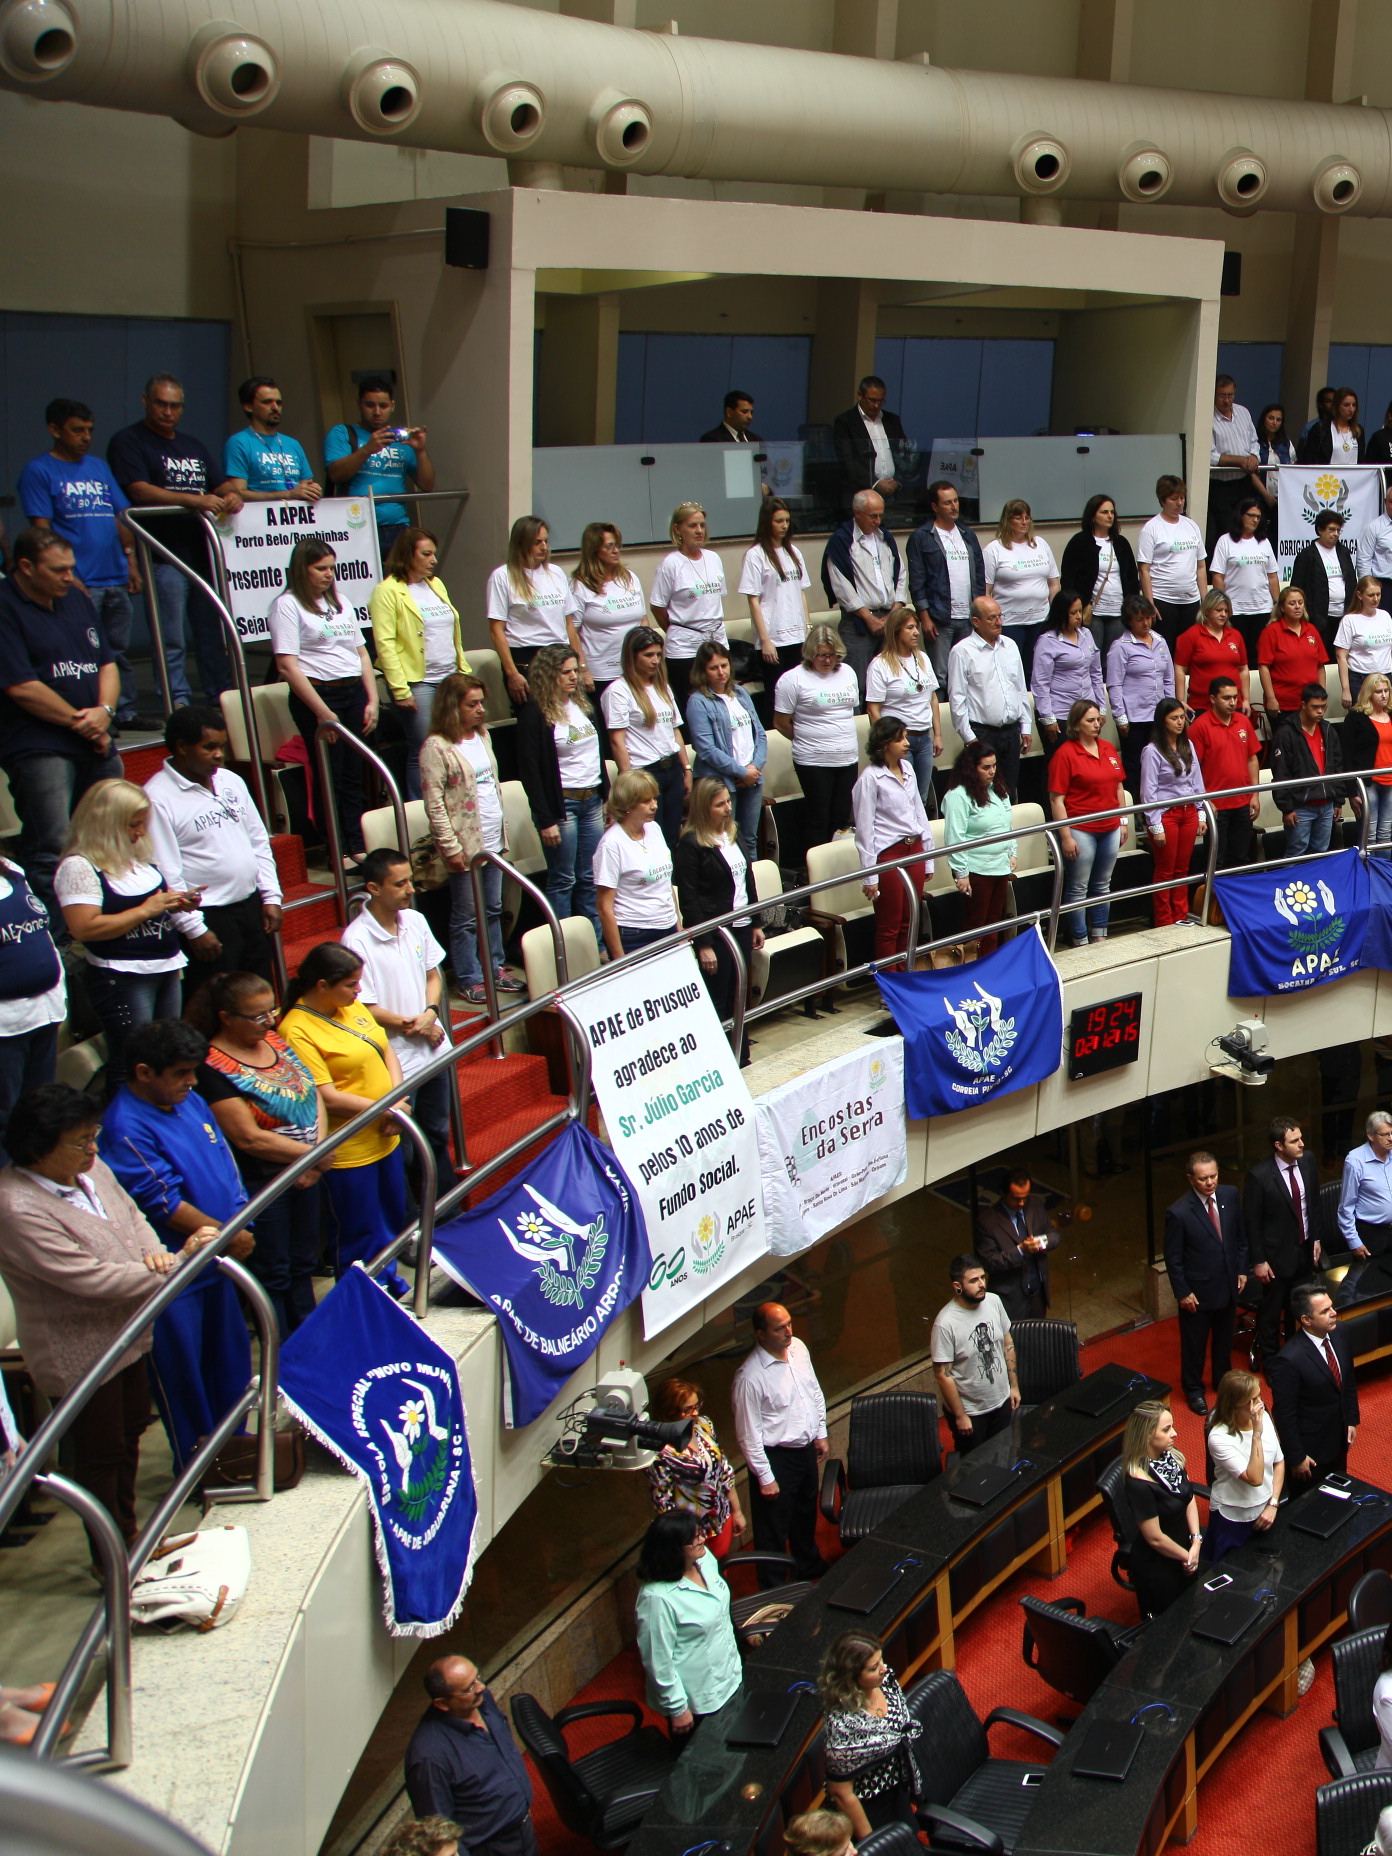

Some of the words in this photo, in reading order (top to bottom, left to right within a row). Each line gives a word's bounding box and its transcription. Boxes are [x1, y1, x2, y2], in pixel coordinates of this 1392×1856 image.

[166, 457, 201, 473] APAE
[66, 482, 104, 497] APAE
[266, 508, 278, 527] A
[280, 505, 316, 527] APAE
[235, 533, 265, 549] Porto
[226, 567, 283, 591] Presente
[1328, 965, 1346, 976] SUL
[589, 1012, 627, 1049] APAE
[625, 1007, 645, 1031] de
[643, 982, 701, 1022] Brusque
[1087, 1006, 1107, 1032] 19
[1109, 1000, 1137, 1027] 24
[1124, 1022, 1138, 1042] 15
[613, 1041, 678, 1089] agradece
[679, 1033, 698, 1055] ao
[973, 1074, 996, 1085] APAE
[618, 1113, 644, 1138] Sr.
[644, 1093, 679, 1125] Júlio
[676, 1069, 725, 1105] Garcia
[951, 1083, 979, 1095] CORREIA
[801, 1095, 873, 1146] Encostas
[816, 1138, 836, 1160] da
[840, 1111, 884, 1146] Serra
[638, 1147, 678, 1186] pelos
[675, 1134, 694, 1159] 10
[694, 1118, 727, 1150] anos
[725, 1108, 745, 1131] de
[658, 1182, 696, 1222] Fundo
[727, 1198, 756, 1235] APAE
[669, 1272, 688, 1289] ANOS
[490, 1294, 523, 1334] APAE
[522, 1327, 540, 1350] DE
[540, 1315, 597, 1356] BALNEÁRIO
[351, 1378, 372, 1439] ESPECIAL
[366, 1441, 392, 1506] ESCOLA
[392, 1523, 412, 1549] APAE
[412, 1536, 423, 1550] DE
[423, 1470, 461, 1546] JAGUARUNA
[453, 1434, 463, 1457] SC
